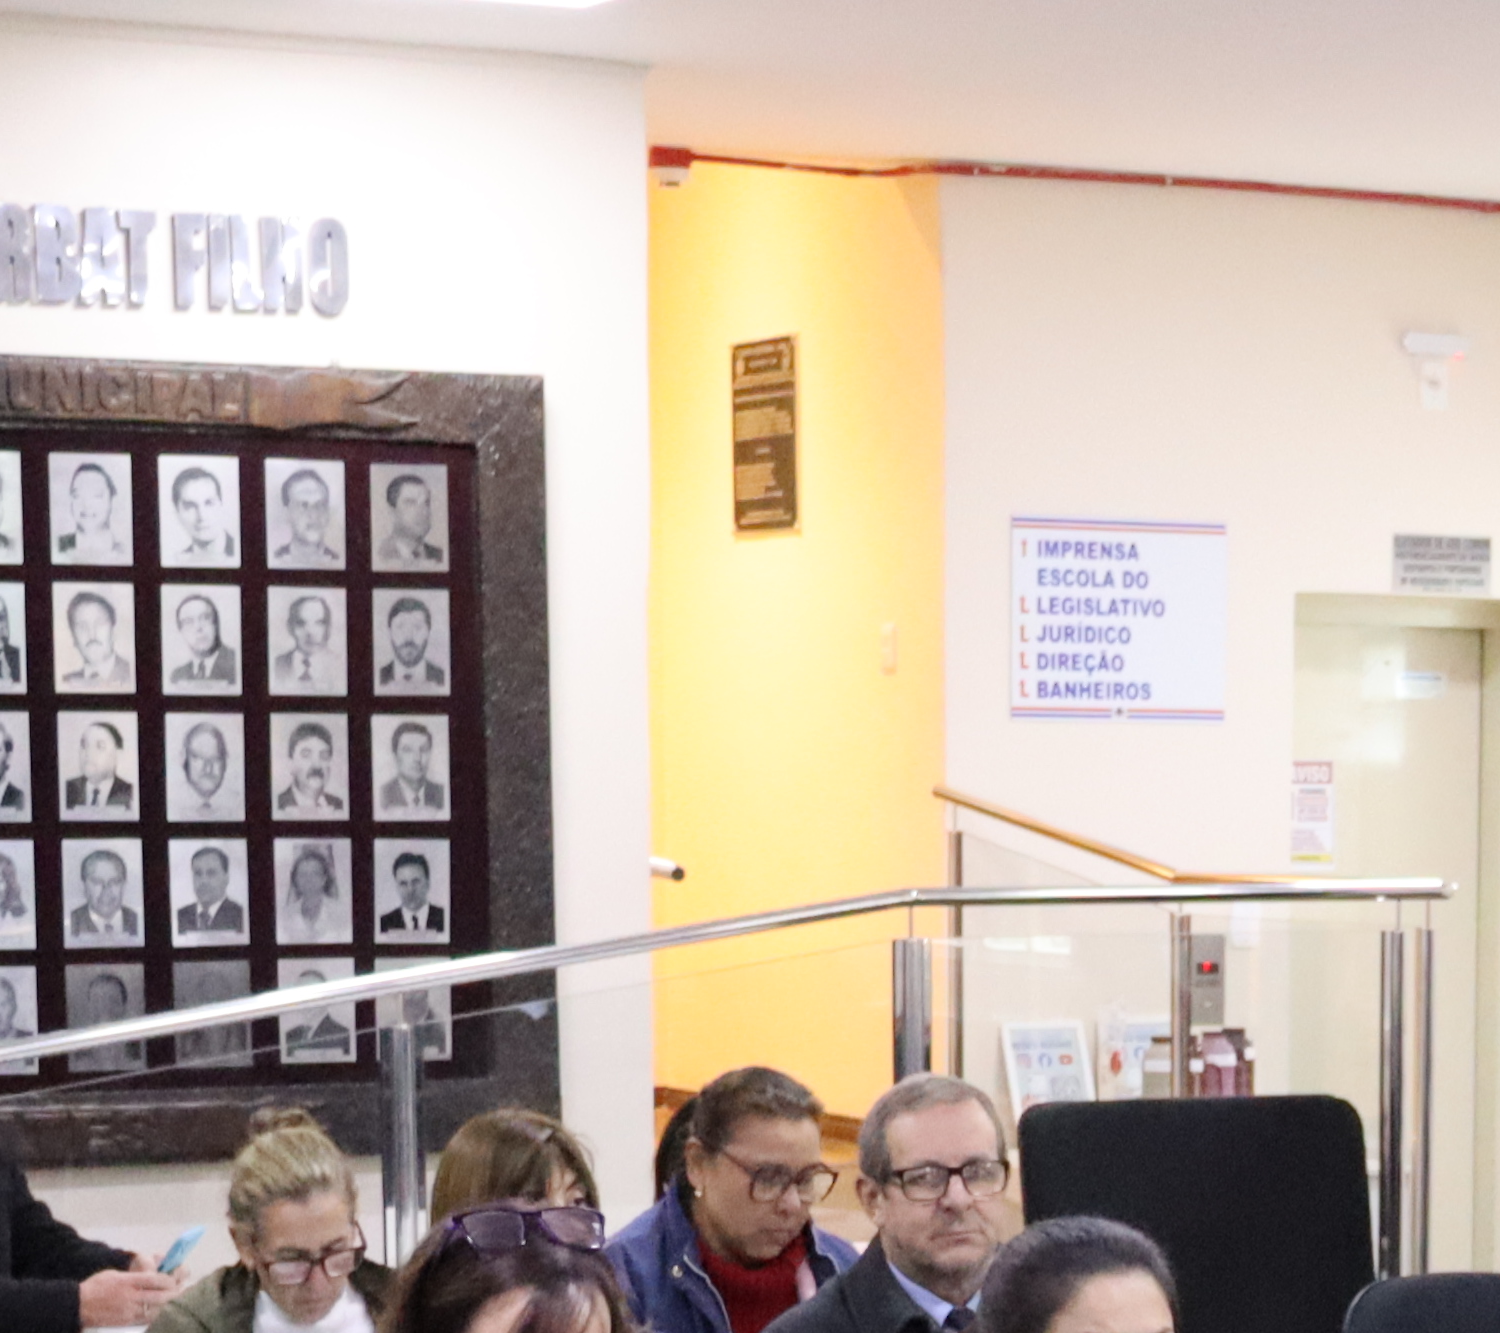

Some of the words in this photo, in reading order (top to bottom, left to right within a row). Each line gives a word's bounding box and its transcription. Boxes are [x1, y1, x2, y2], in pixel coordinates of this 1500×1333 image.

[172, 212, 348, 317] FILHO
[1037, 540, 1139, 561] IMPRENSA
[1037, 568, 1115, 588] ESCOLA
[1122, 571, 1149, 589] DO
[1036, 596, 1166, 617] LEGISLATIVO
[1036, 622, 1132, 644] JURÍDICO
[1037, 650, 1125, 676] DIREÇÃO
[1037, 681, 1152, 700] BANHEIROS
